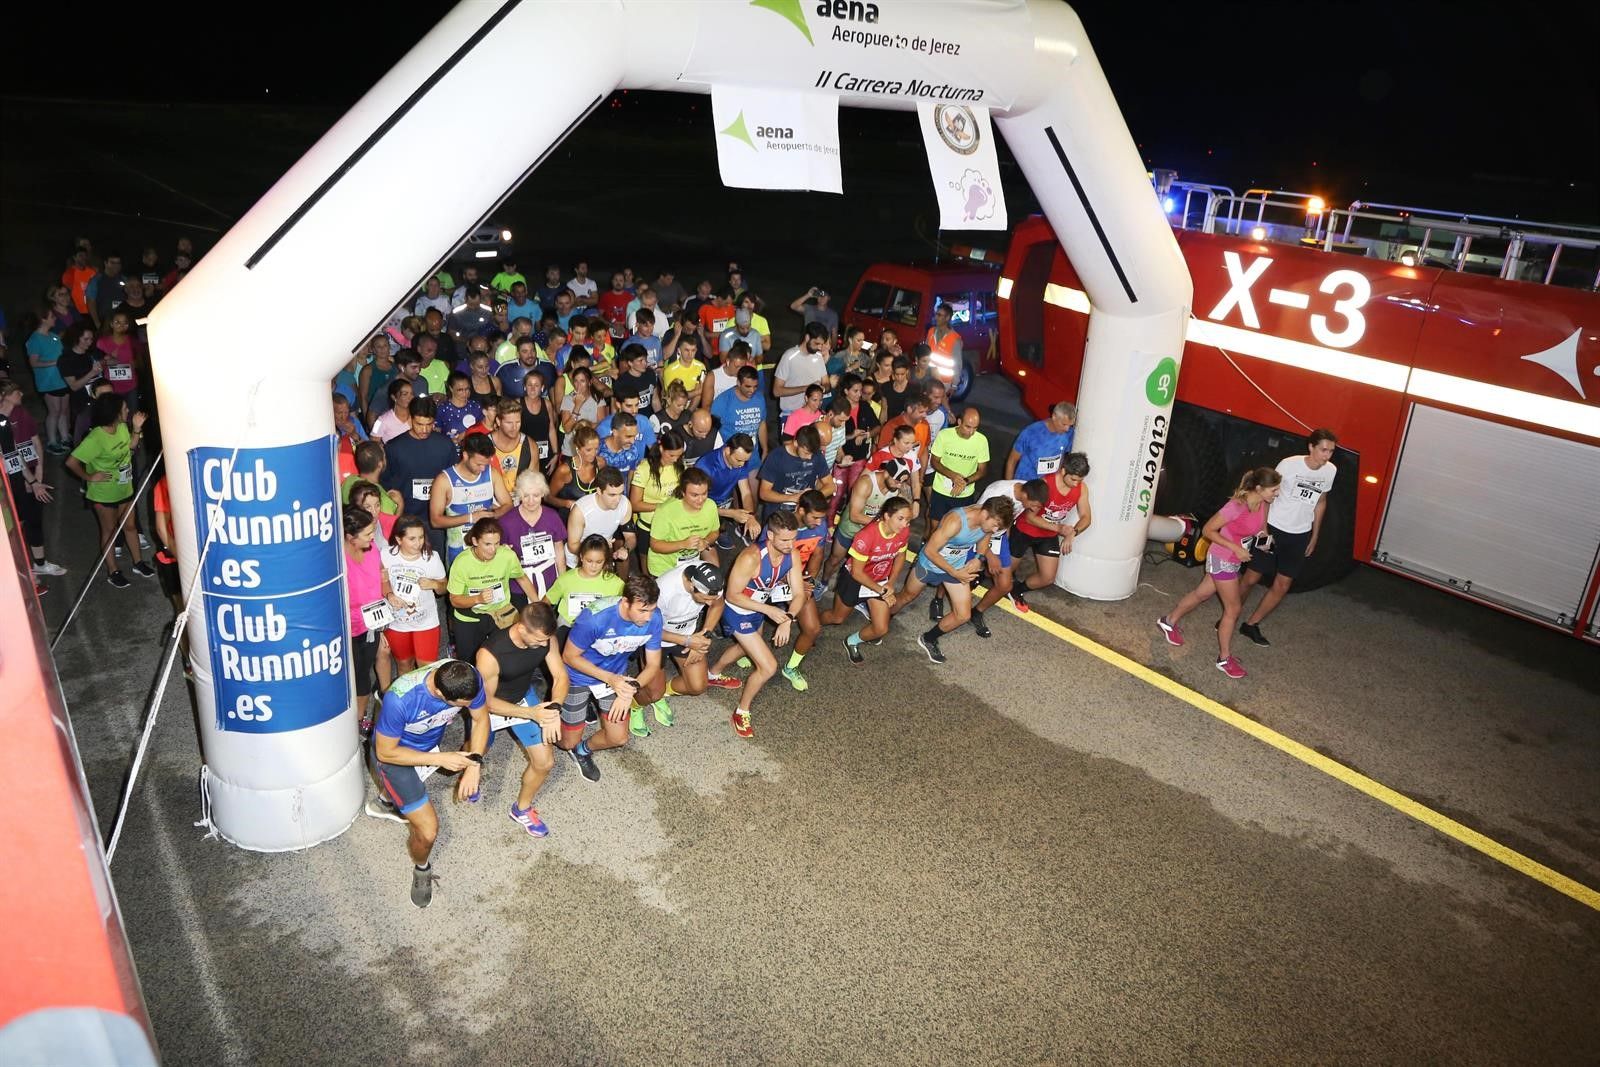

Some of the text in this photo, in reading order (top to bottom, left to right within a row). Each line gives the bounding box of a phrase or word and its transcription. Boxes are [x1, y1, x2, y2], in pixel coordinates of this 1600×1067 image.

[816, 0, 879, 24] aena
[911, 36, 926, 51] de
[929, 38, 961, 56] Jerez
[815, 70, 985, 102] II Carrera Nocturna
[756, 126, 794, 139] aena
[766, 141, 812, 152] Aeropuerto
[814, 144, 822, 153] de
[1207, 251, 1371, 348] X-3
[1157, 374, 1171, 399] er
[203, 458, 277, 502] Club
[1300, 489, 1313, 499] 151
[206, 500, 333, 545] Running
[532, 545, 545, 556] 53
[213, 558, 261, 588] .es
[217, 603, 287, 642] Club
[372, 609, 384, 621] 111
[220, 636, 343, 683] Running
[227, 694, 273, 721] .es
